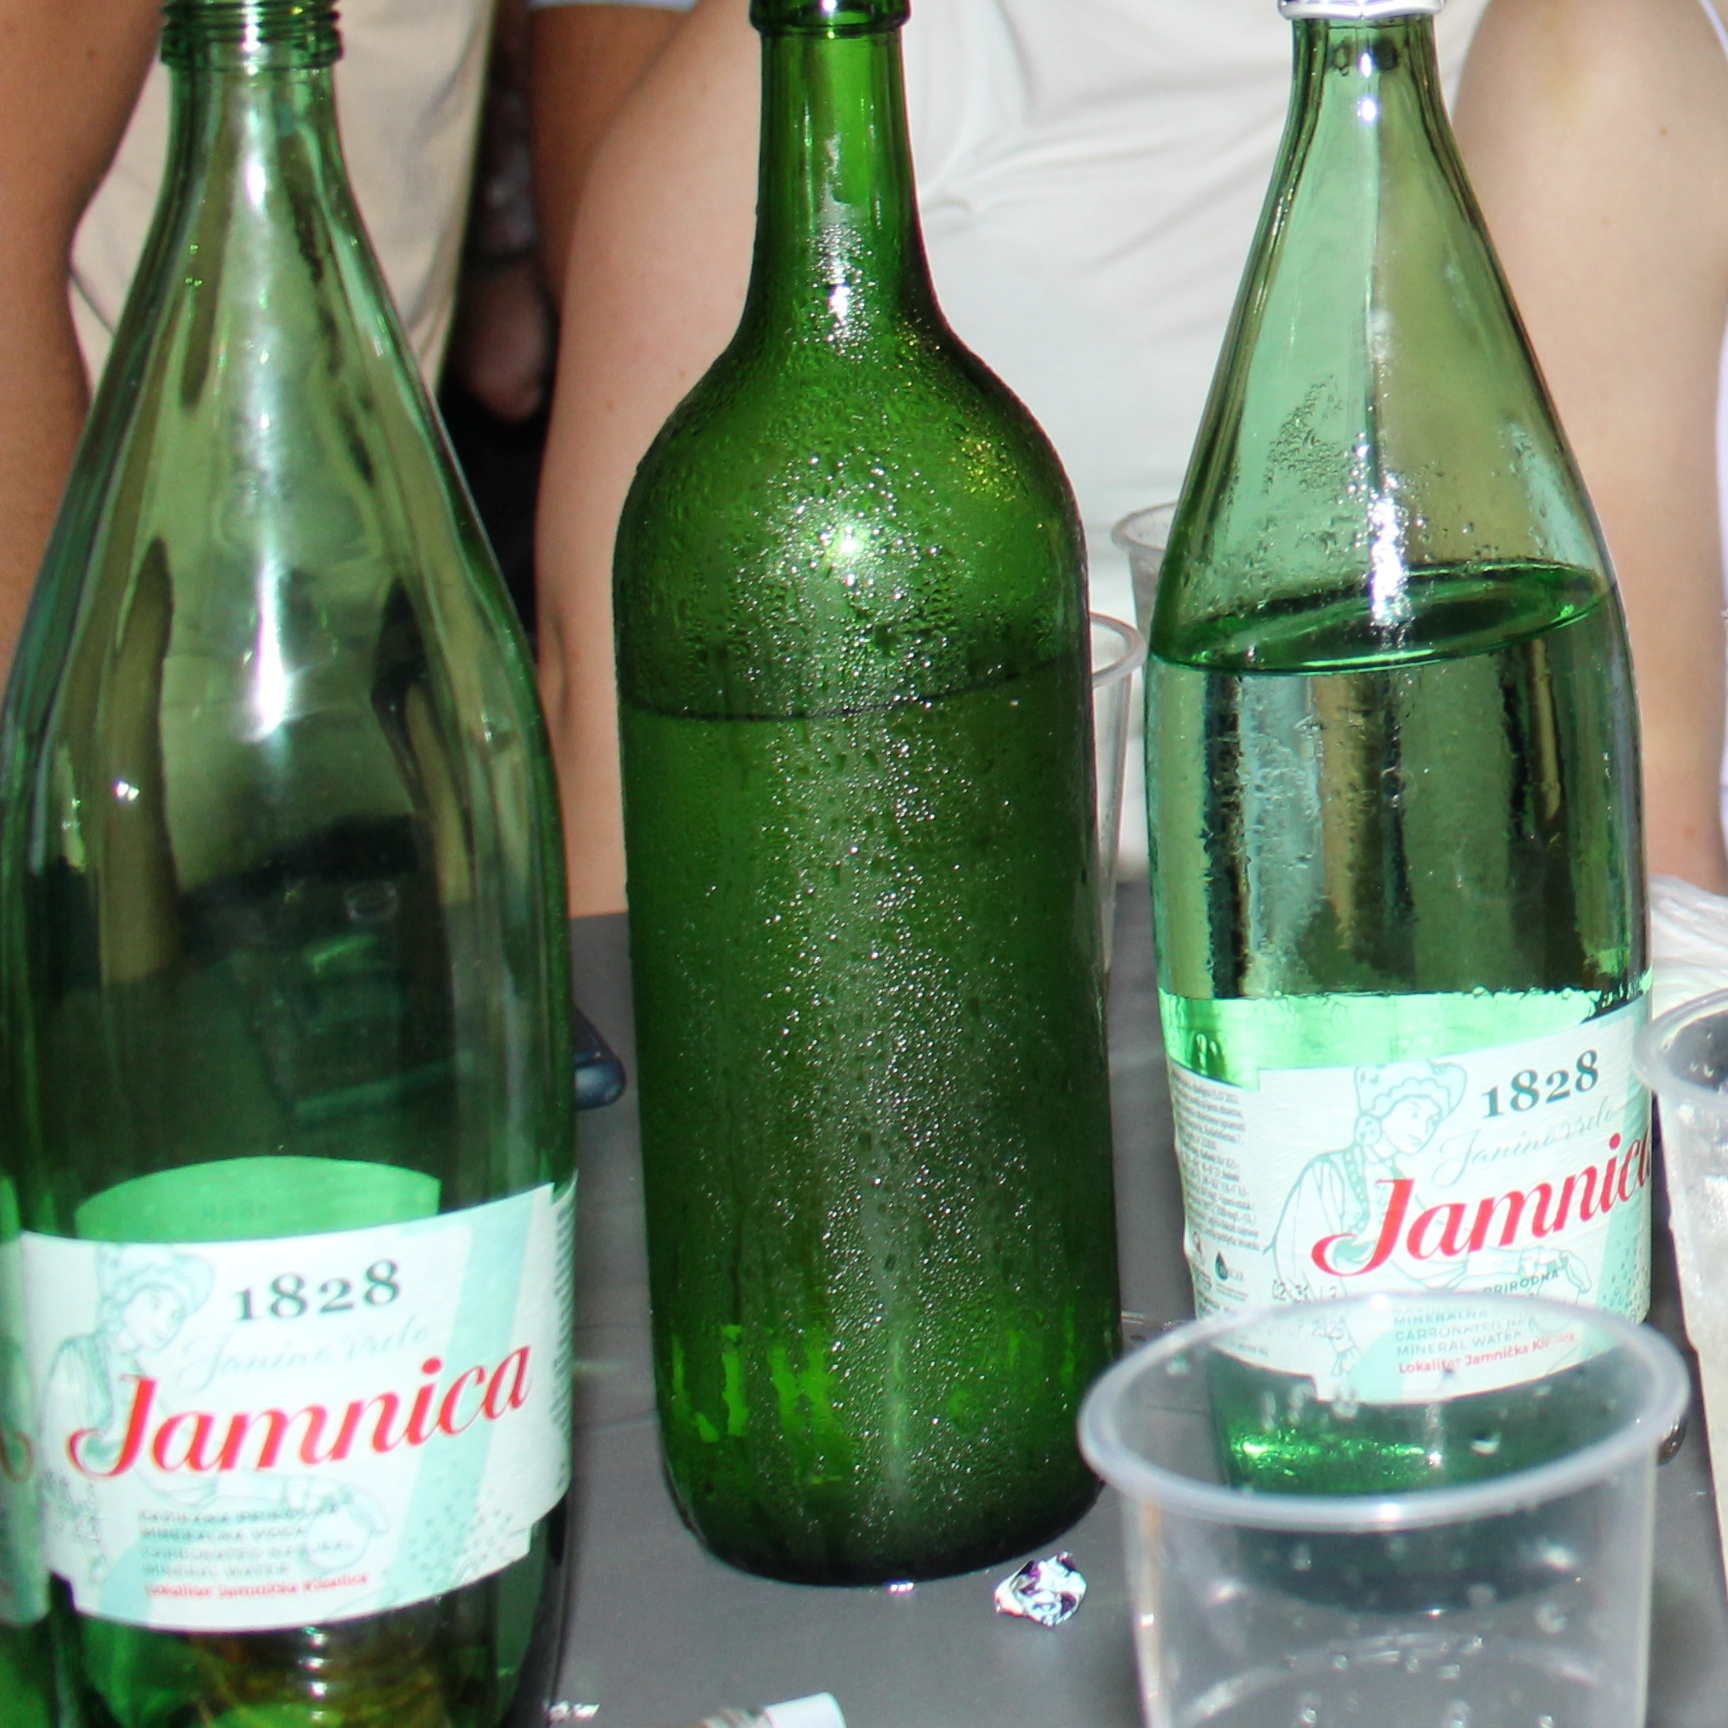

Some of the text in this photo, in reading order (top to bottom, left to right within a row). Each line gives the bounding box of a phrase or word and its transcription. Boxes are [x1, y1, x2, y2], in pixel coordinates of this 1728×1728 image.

[1482, 1049, 1599, 1119] 1828
[233, 1259, 401, 1321] 1828
[1396, 1339, 1467, 1359] MINERAL
[1465, 1344, 1529, 1367] Jamnička
[67, 1344, 533, 1480] Jamnica
